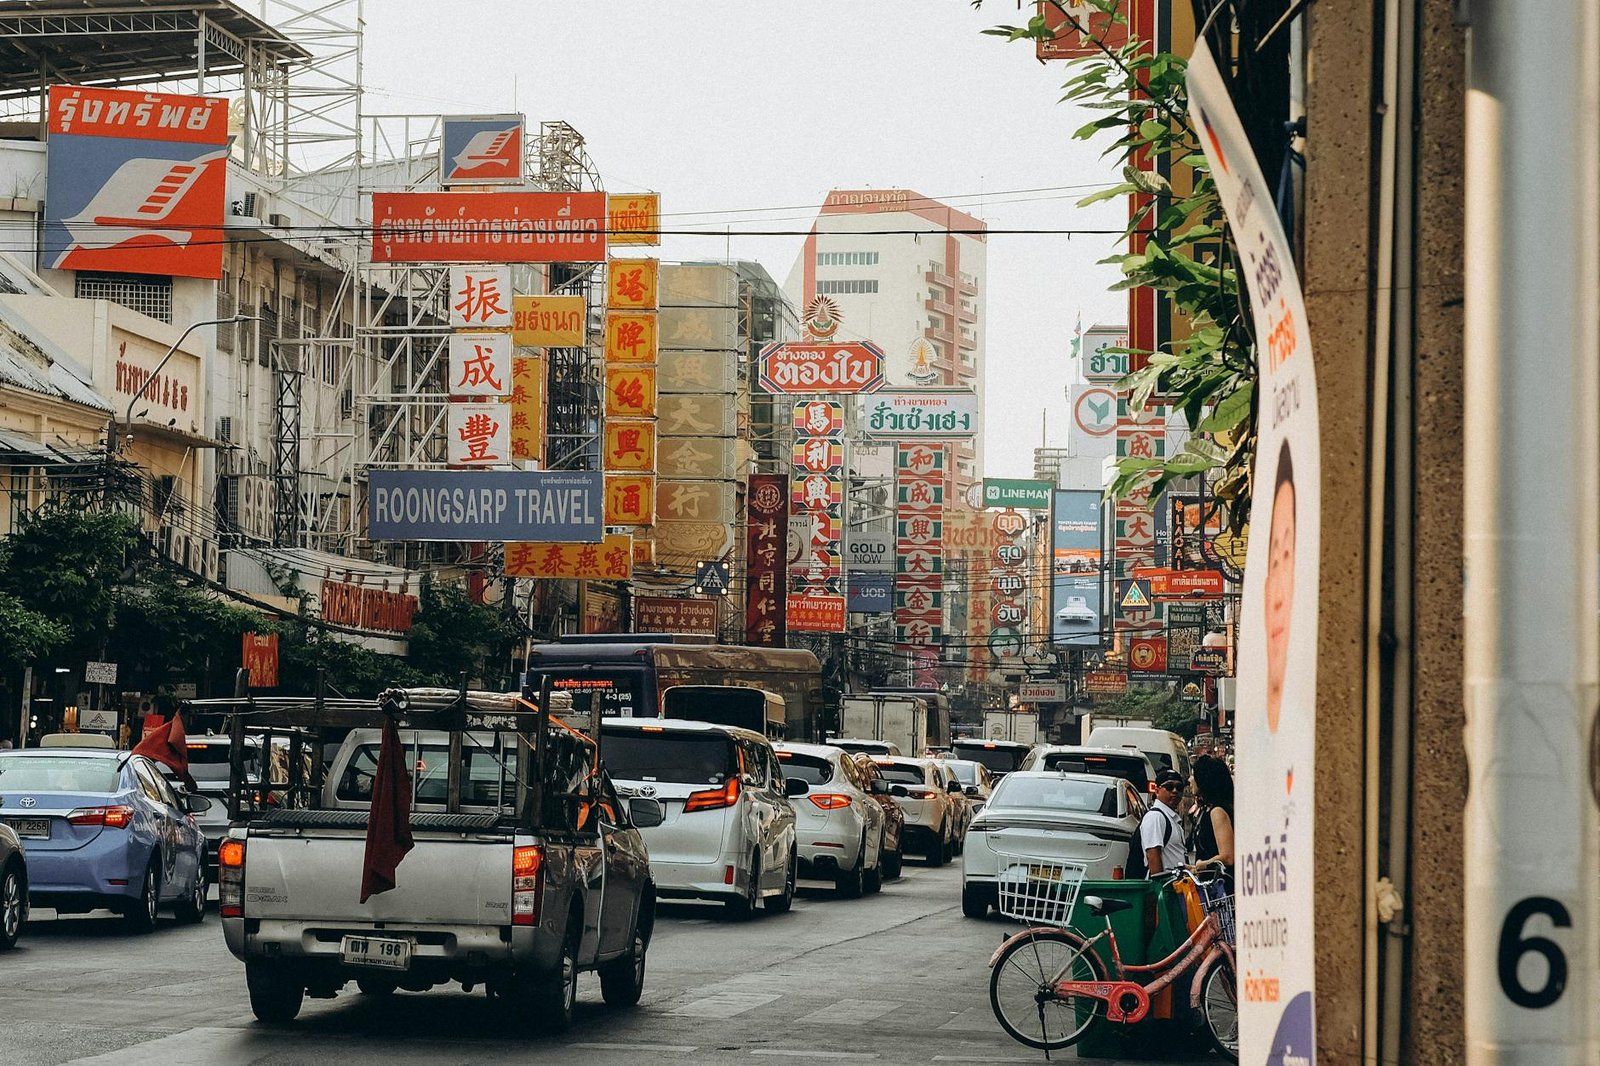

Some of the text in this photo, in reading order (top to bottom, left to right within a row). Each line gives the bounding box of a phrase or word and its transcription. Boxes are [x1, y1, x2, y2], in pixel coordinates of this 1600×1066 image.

[57, 91, 222, 133] รุ่งทรัพย์
[380, 197, 598, 258] รุ่งทรัพย์การท่องเที่ยว
[870, 401, 970, 431] ฮั่วเซ่งเฮง
[1002, 488, 1026, 498] LINE
[375, 487, 595, 525] ROONGSARP TRAVEL
[850, 543, 886, 554] GOLD
[853, 554, 882, 565] NOW
[861, 586, 886, 598] UOB
[998, 604, 1022, 622] วัน
[380, 942, 402, 957] 196
[1497, 895, 1573, 1010] 6
